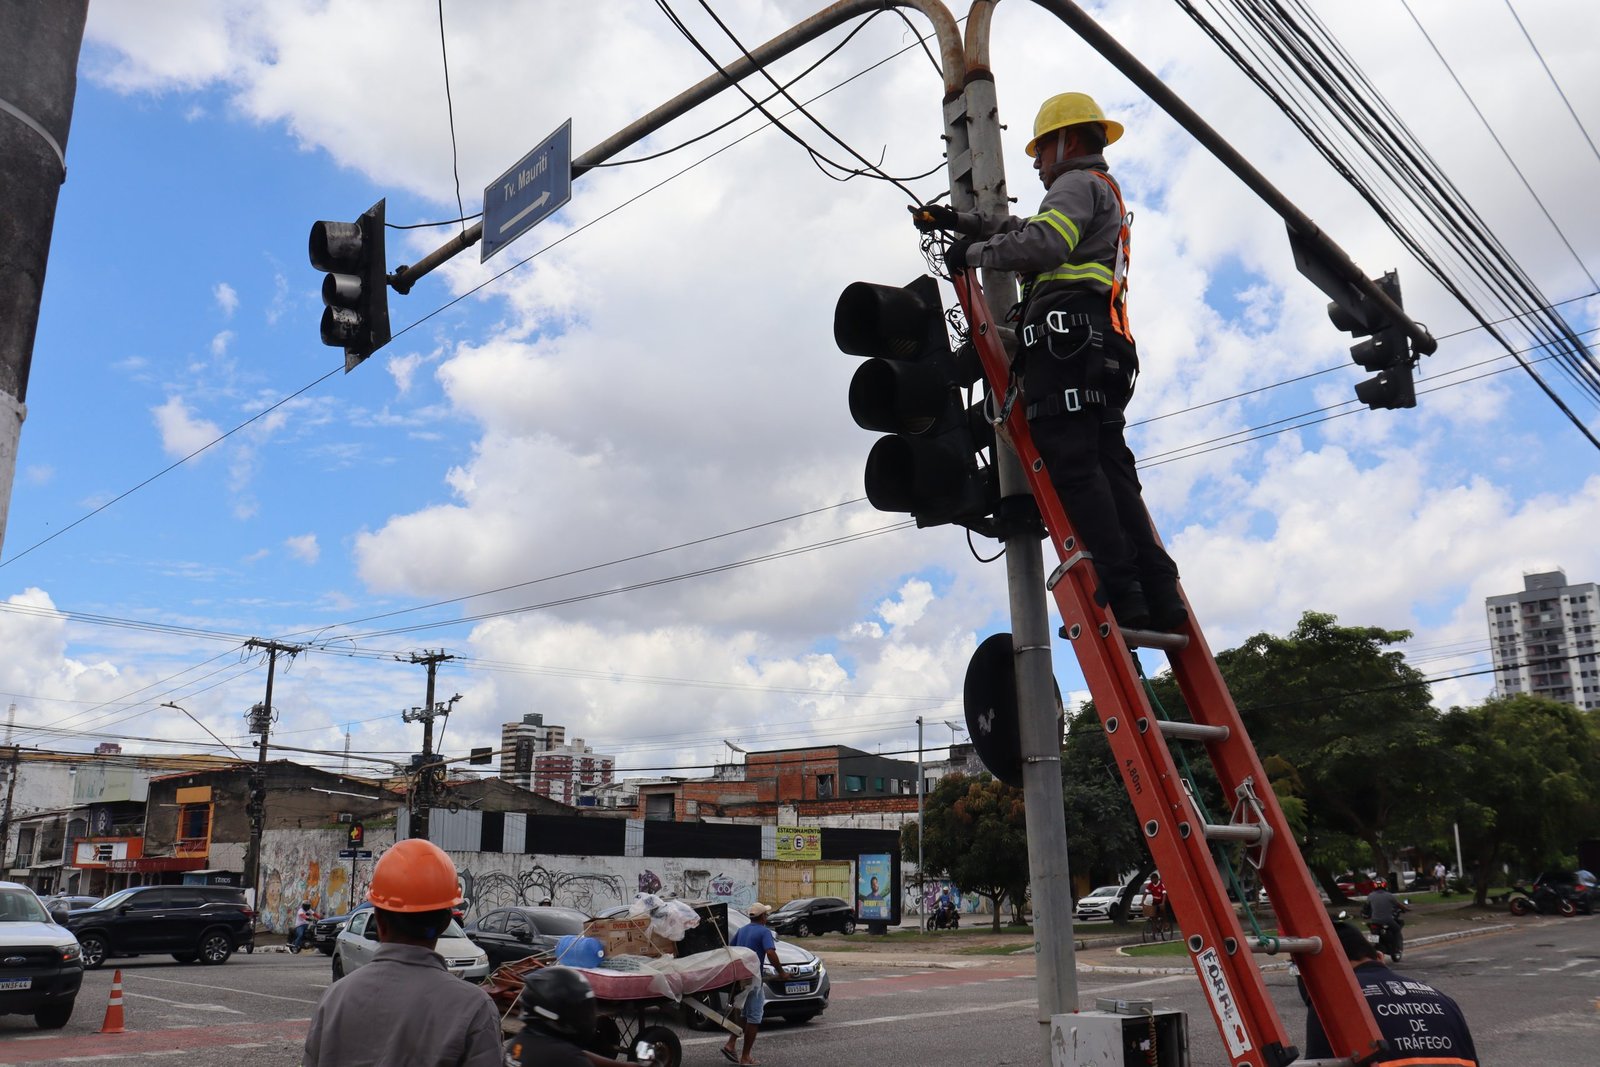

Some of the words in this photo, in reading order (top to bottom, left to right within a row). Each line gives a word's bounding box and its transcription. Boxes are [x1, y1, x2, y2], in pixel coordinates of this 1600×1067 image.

[504, 182, 516, 201] Tv.
[518, 152, 548, 190] Mauriti
[1126, 759, 1143, 795] 4,80m
[1377, 1003, 1444, 1016] CONTROLE
[1409, 1019, 1428, 1032] DE
[1394, 1034, 1451, 1050] TRÁFEGO
